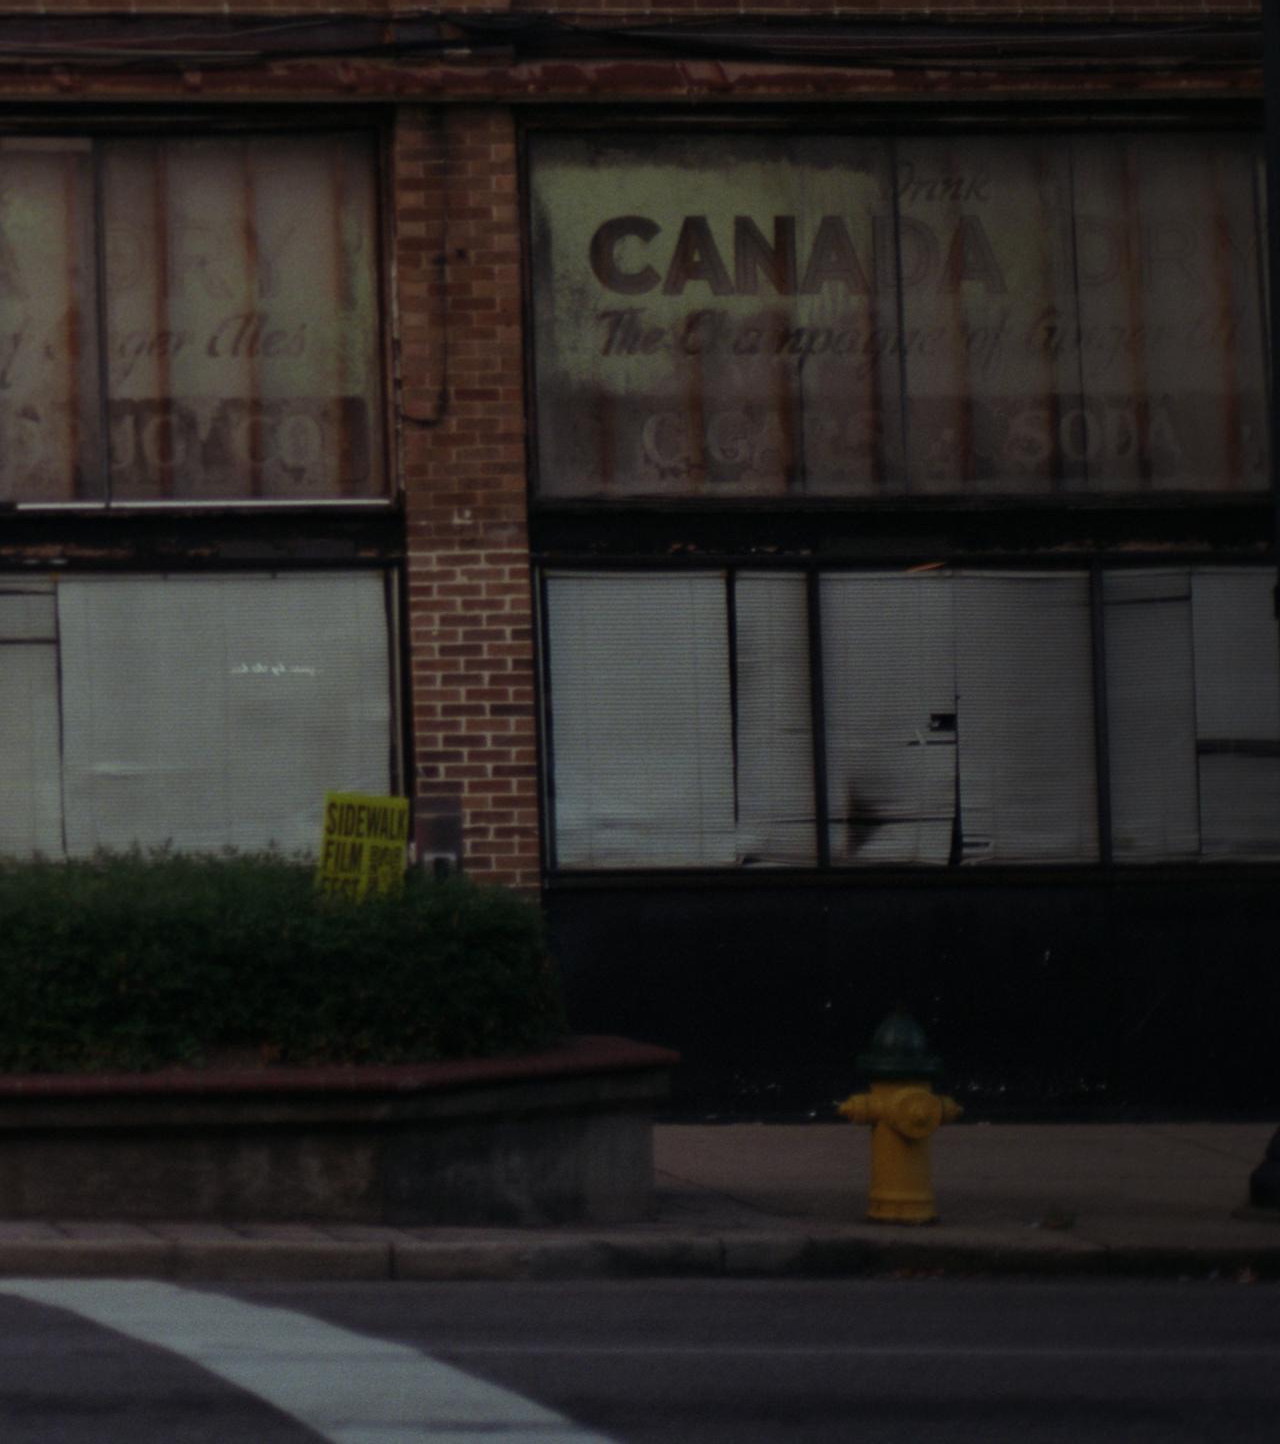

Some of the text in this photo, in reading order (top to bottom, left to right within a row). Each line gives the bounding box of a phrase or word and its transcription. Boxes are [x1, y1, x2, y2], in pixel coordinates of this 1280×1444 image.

[589, 214, 1009, 296] CANADA
[597, 310, 667, 358] The
[326, 802, 408, 841] SIDEWALK
[323, 840, 363, 873] FILM
